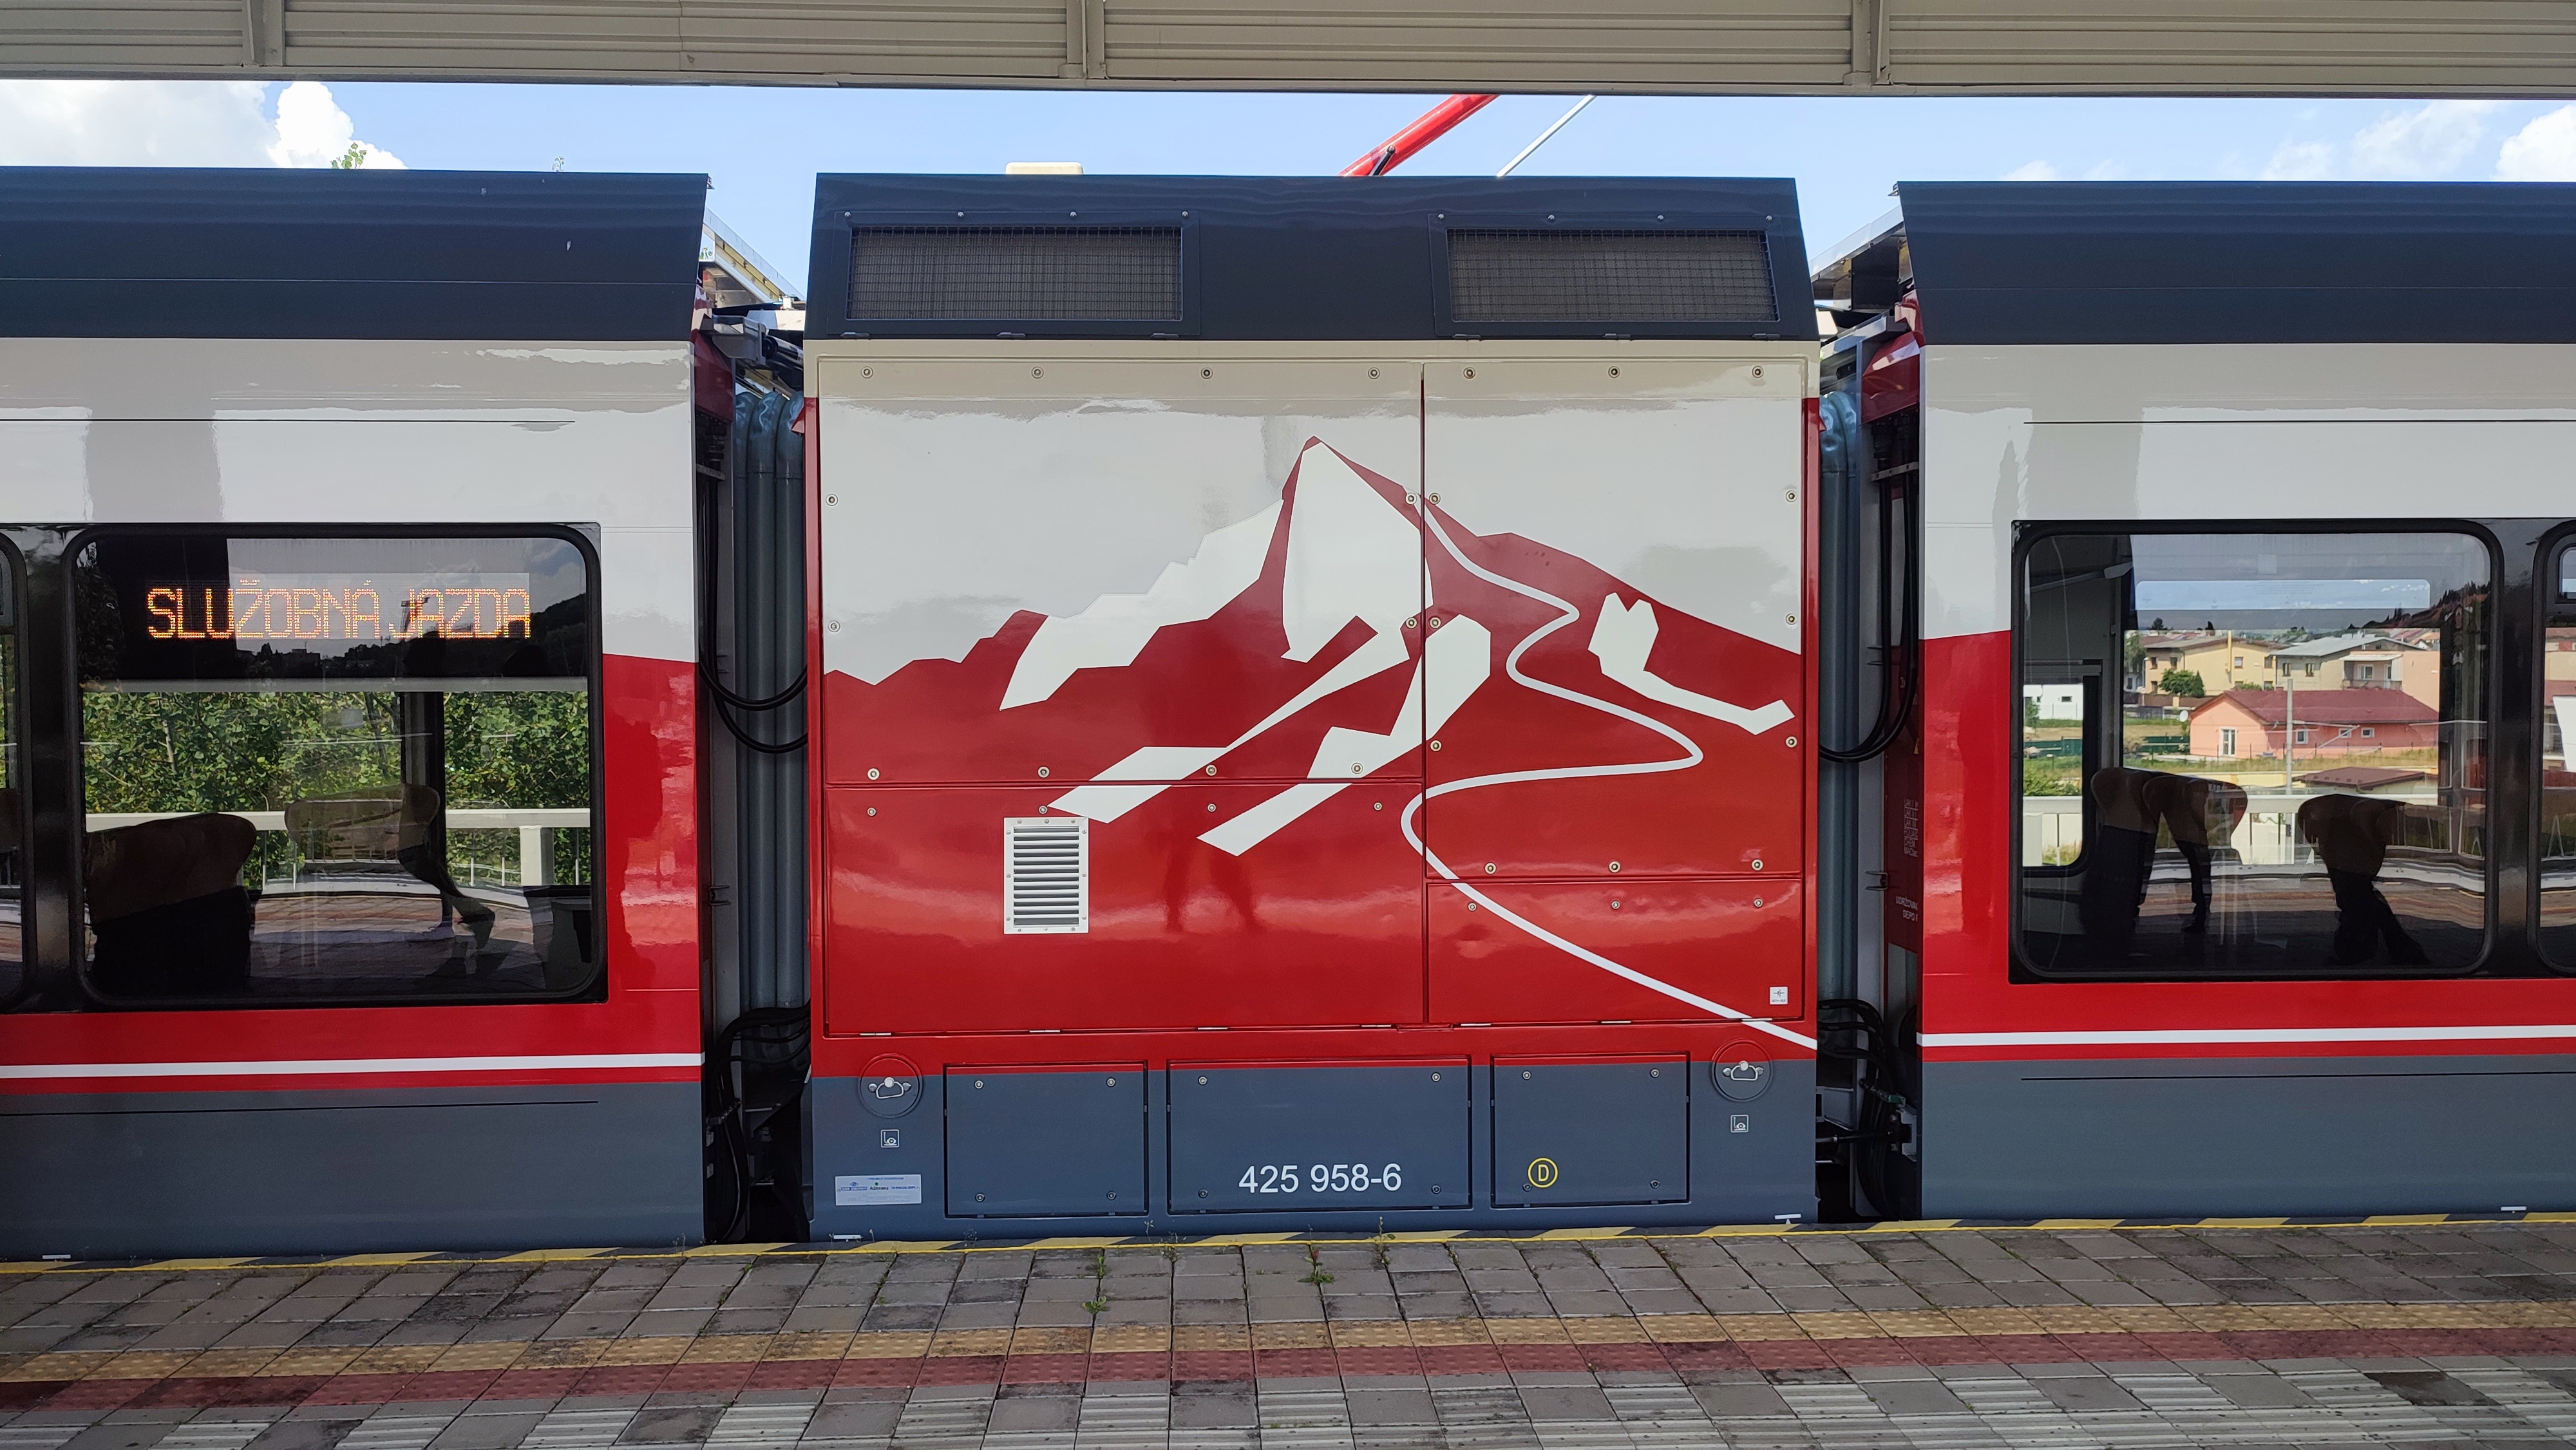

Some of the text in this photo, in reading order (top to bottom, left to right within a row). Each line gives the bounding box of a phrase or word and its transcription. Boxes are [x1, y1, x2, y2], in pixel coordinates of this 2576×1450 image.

[147, 578, 531, 639] SLUŽOBNÁ JAZDA
[1238, 1163, 1402, 1193] 425 958-6
[1537, 1163, 1550, 1182] D
